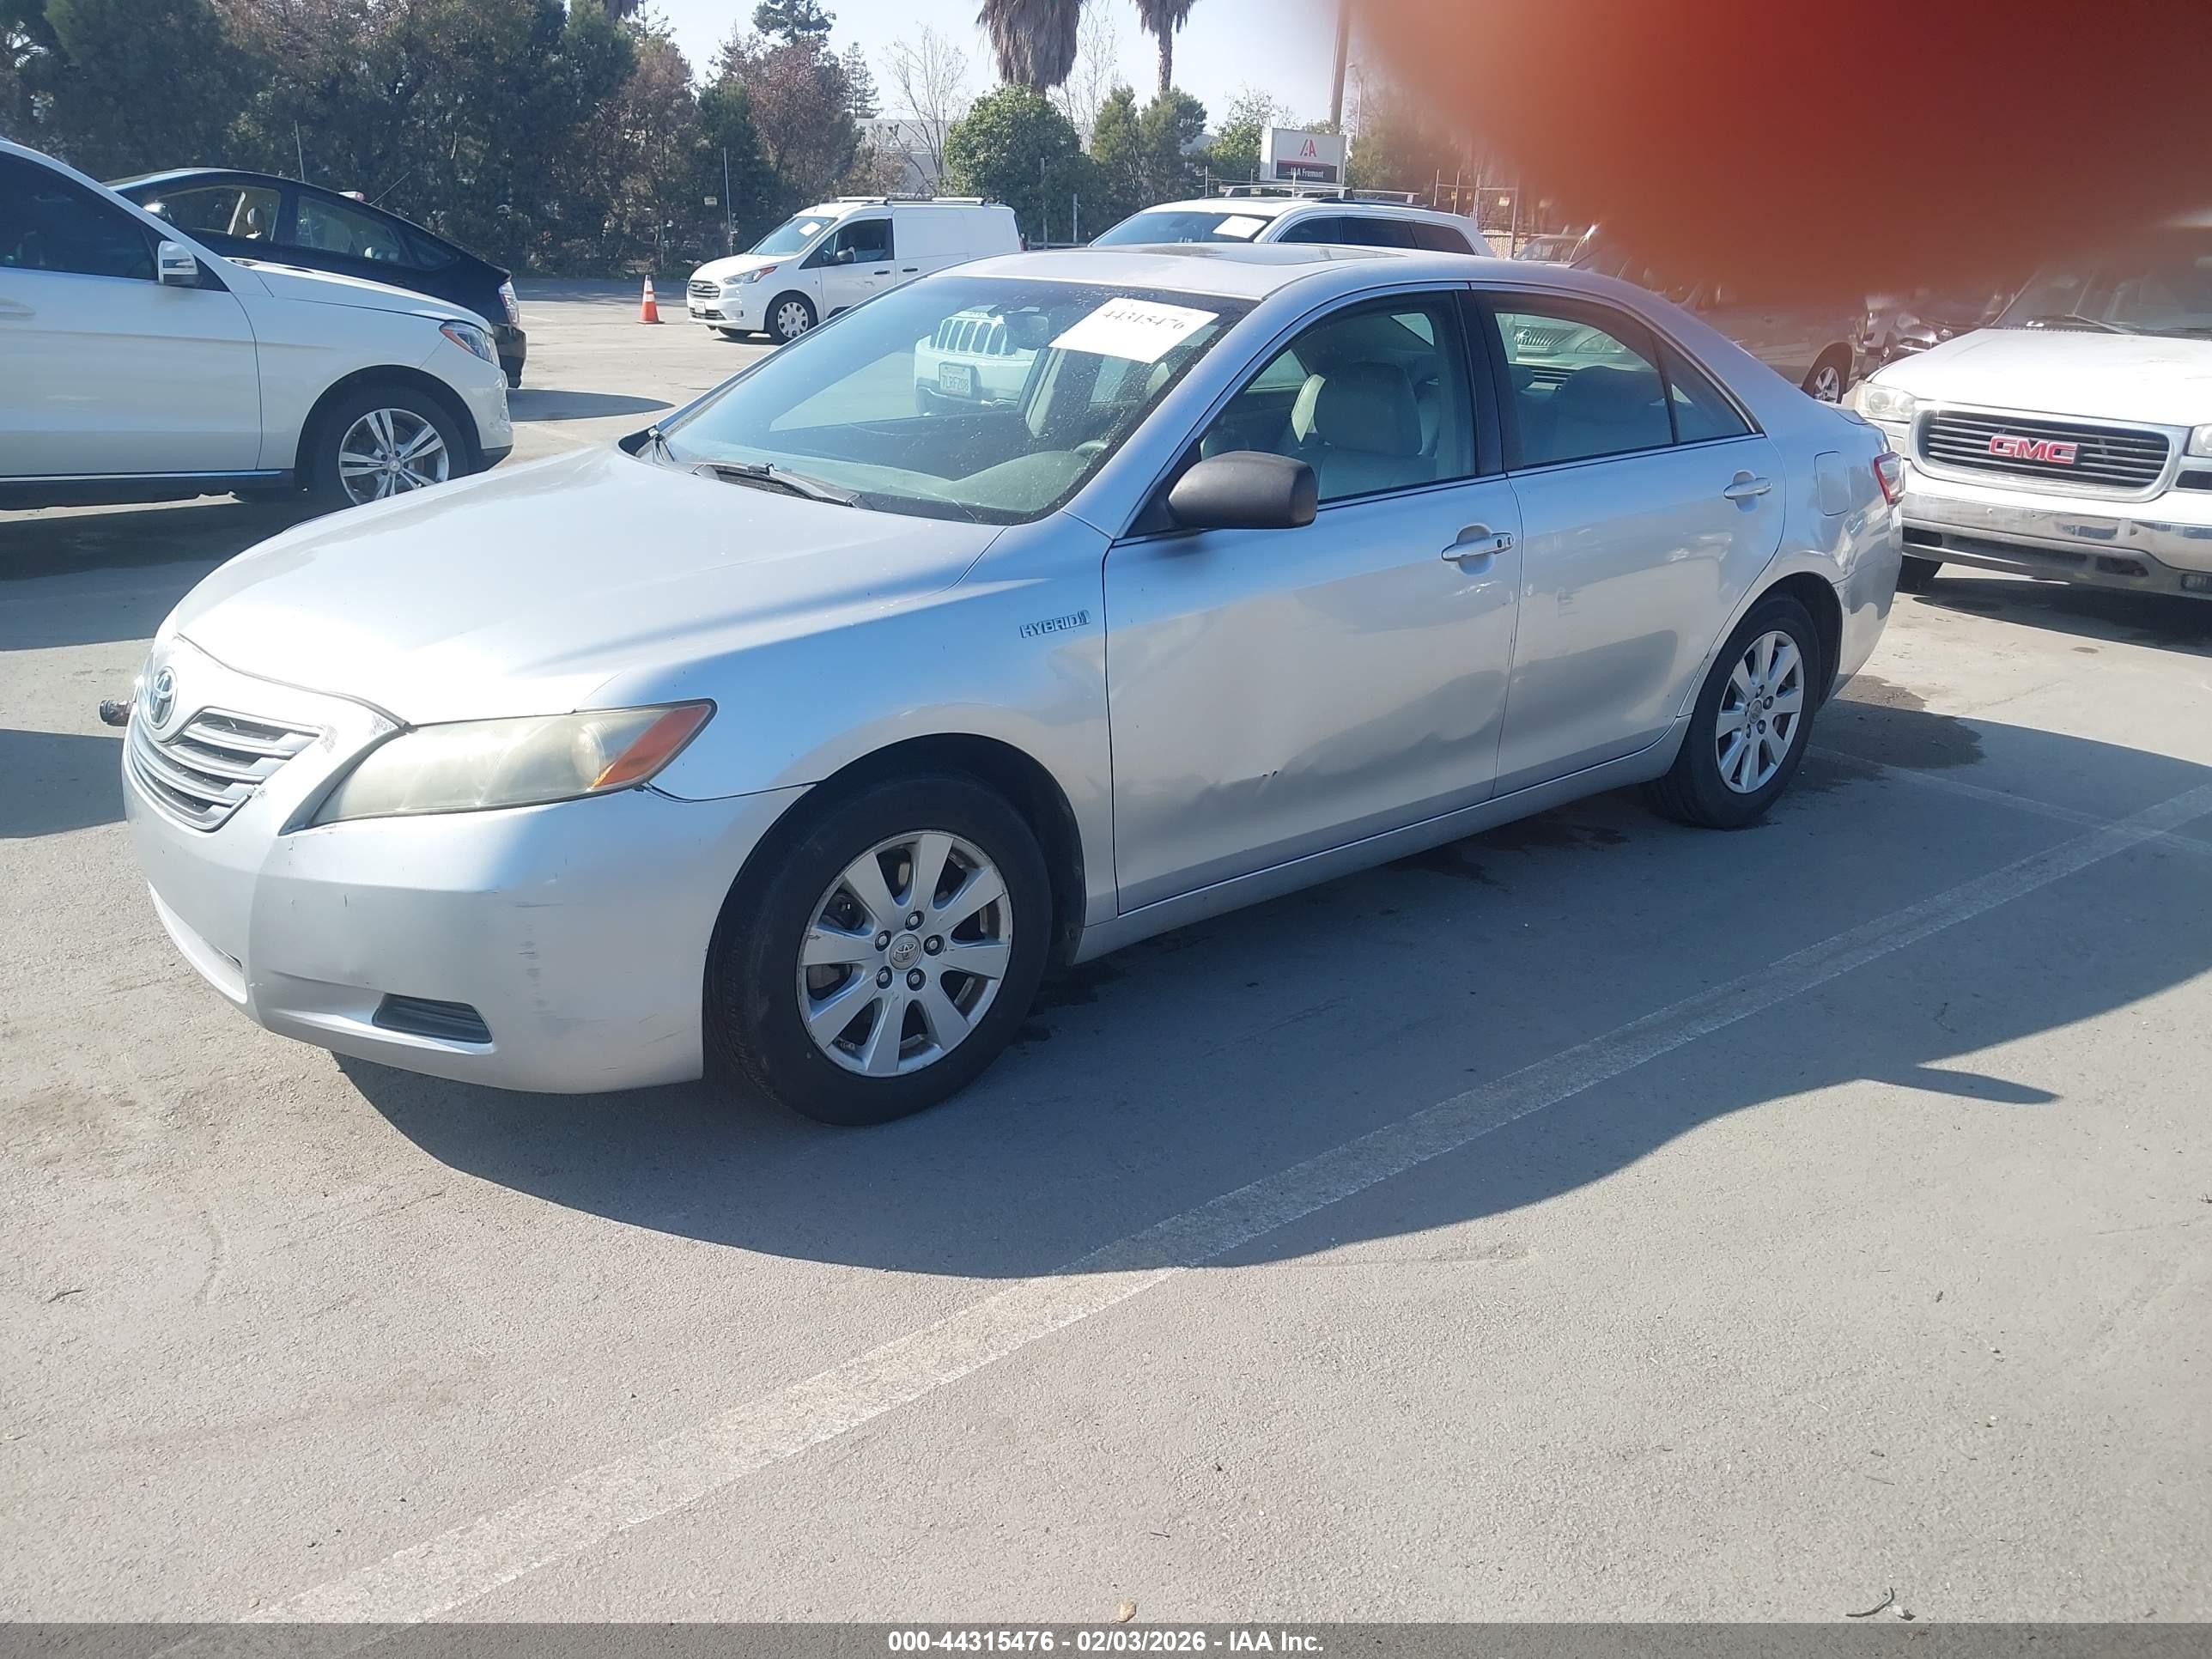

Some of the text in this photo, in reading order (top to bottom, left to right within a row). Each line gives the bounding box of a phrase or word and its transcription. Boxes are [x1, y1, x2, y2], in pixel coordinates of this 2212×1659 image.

[1302, 167, 1323, 179] Fremont
[1989, 435, 2078, 465] GMC
[1019, 614, 1080, 639] HYBRID
